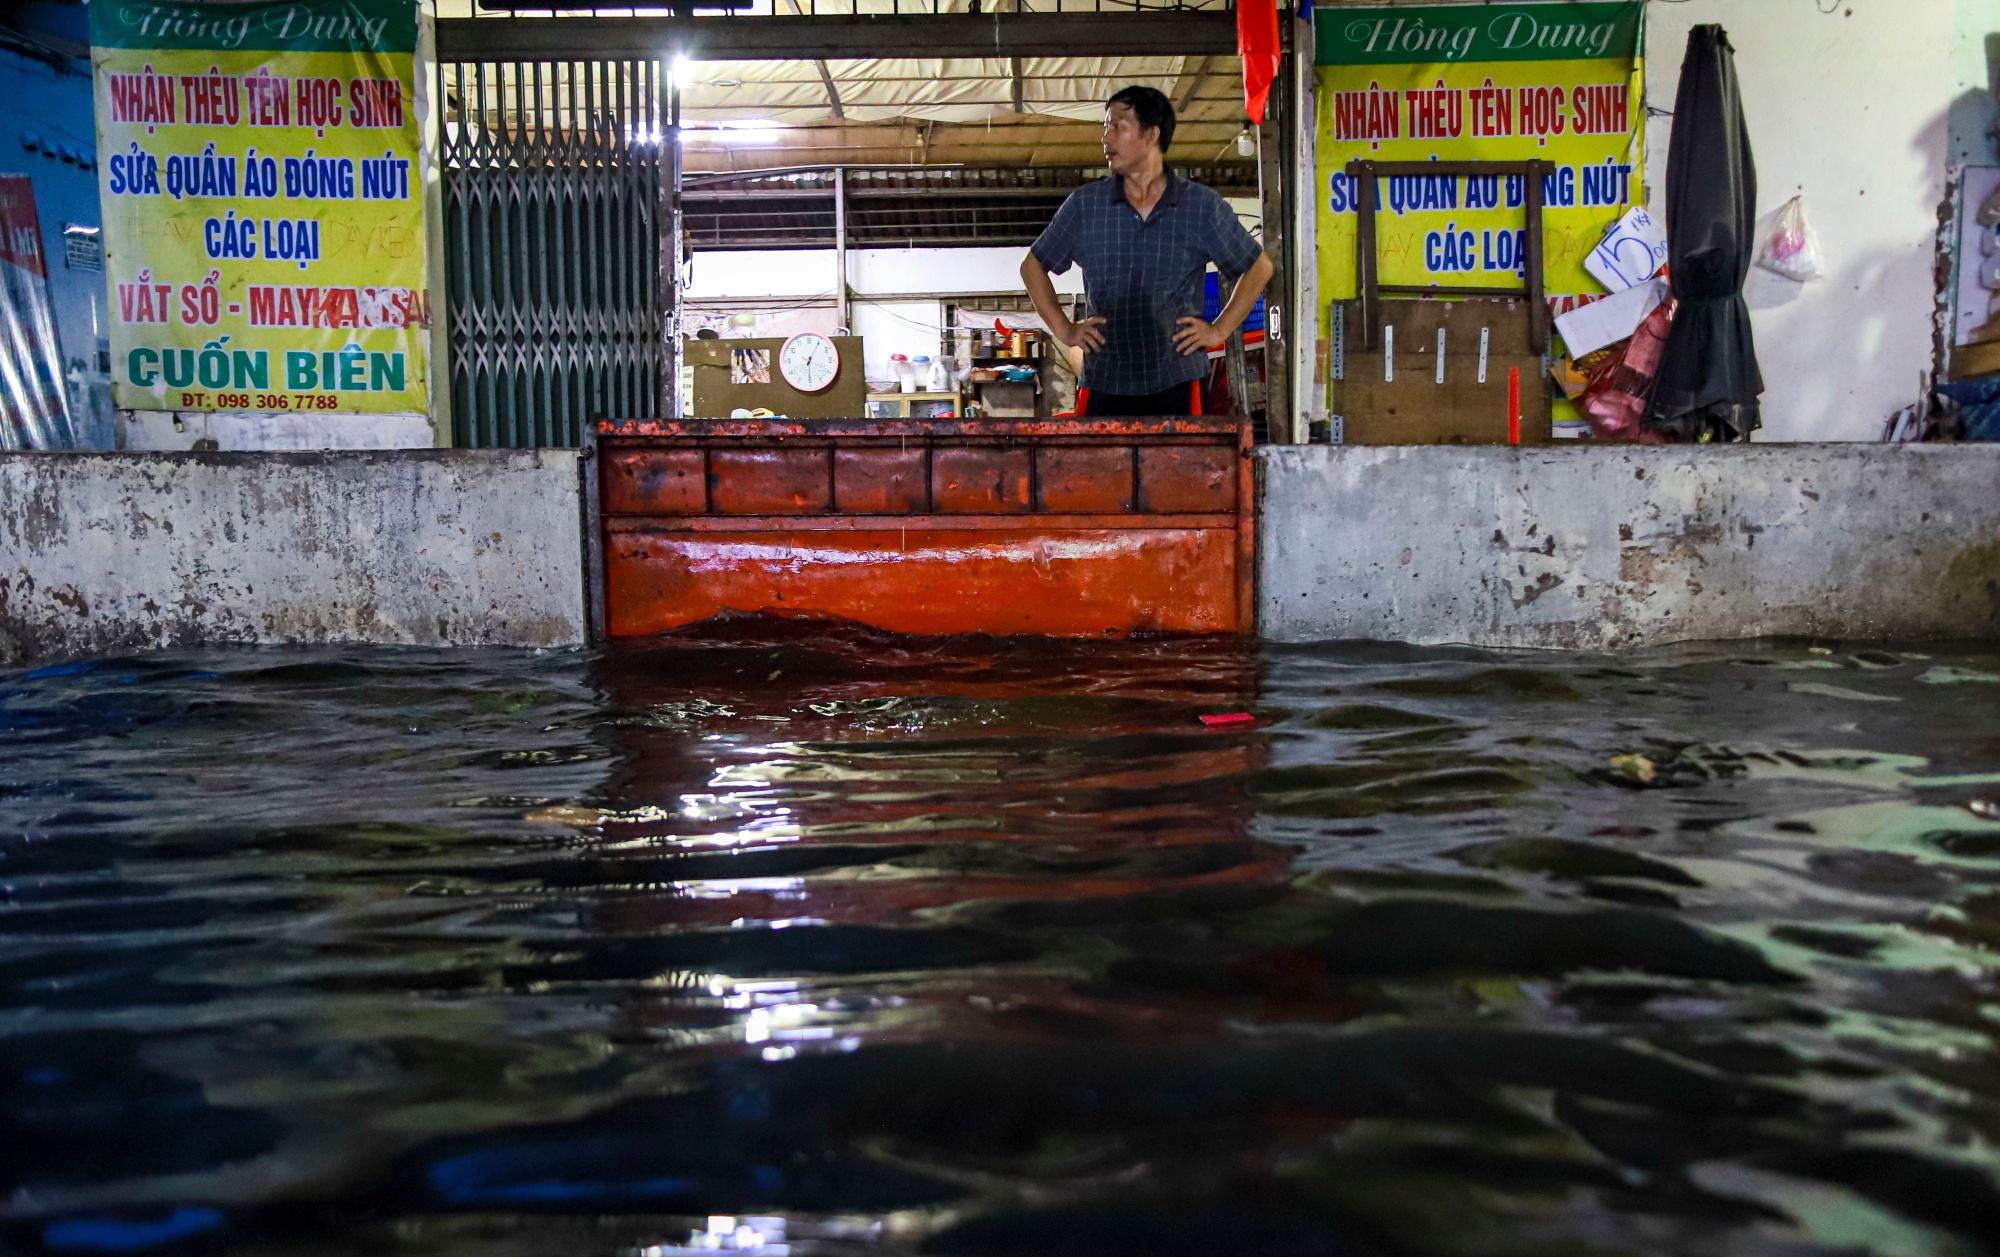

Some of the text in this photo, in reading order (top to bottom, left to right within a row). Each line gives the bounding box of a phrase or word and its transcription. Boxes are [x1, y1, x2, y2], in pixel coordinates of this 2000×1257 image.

[1344, 12, 1615, 59] Hồng Dung
[110, 64, 402, 138] NHẬN THÊU TÊN HỌC SINH
[1335, 78, 1627, 149] NHẬN THÊU TÊN HỌC SINH
[109, 142, 409, 199] SỬA QUẦN ÁO ĐÓNG NÚT
[1582, 157, 1632, 206] NÚT
[205, 211, 319, 269] CÁC LOẠI
[1426, 223, 1475, 271] CÁC
[119, 269, 172, 324] VẮT
[182, 270, 219, 325] SỔ
[128, 336, 405, 391] CUỐN BIÊN
[182, 393, 338, 410] ĐT: 098 306 7788
